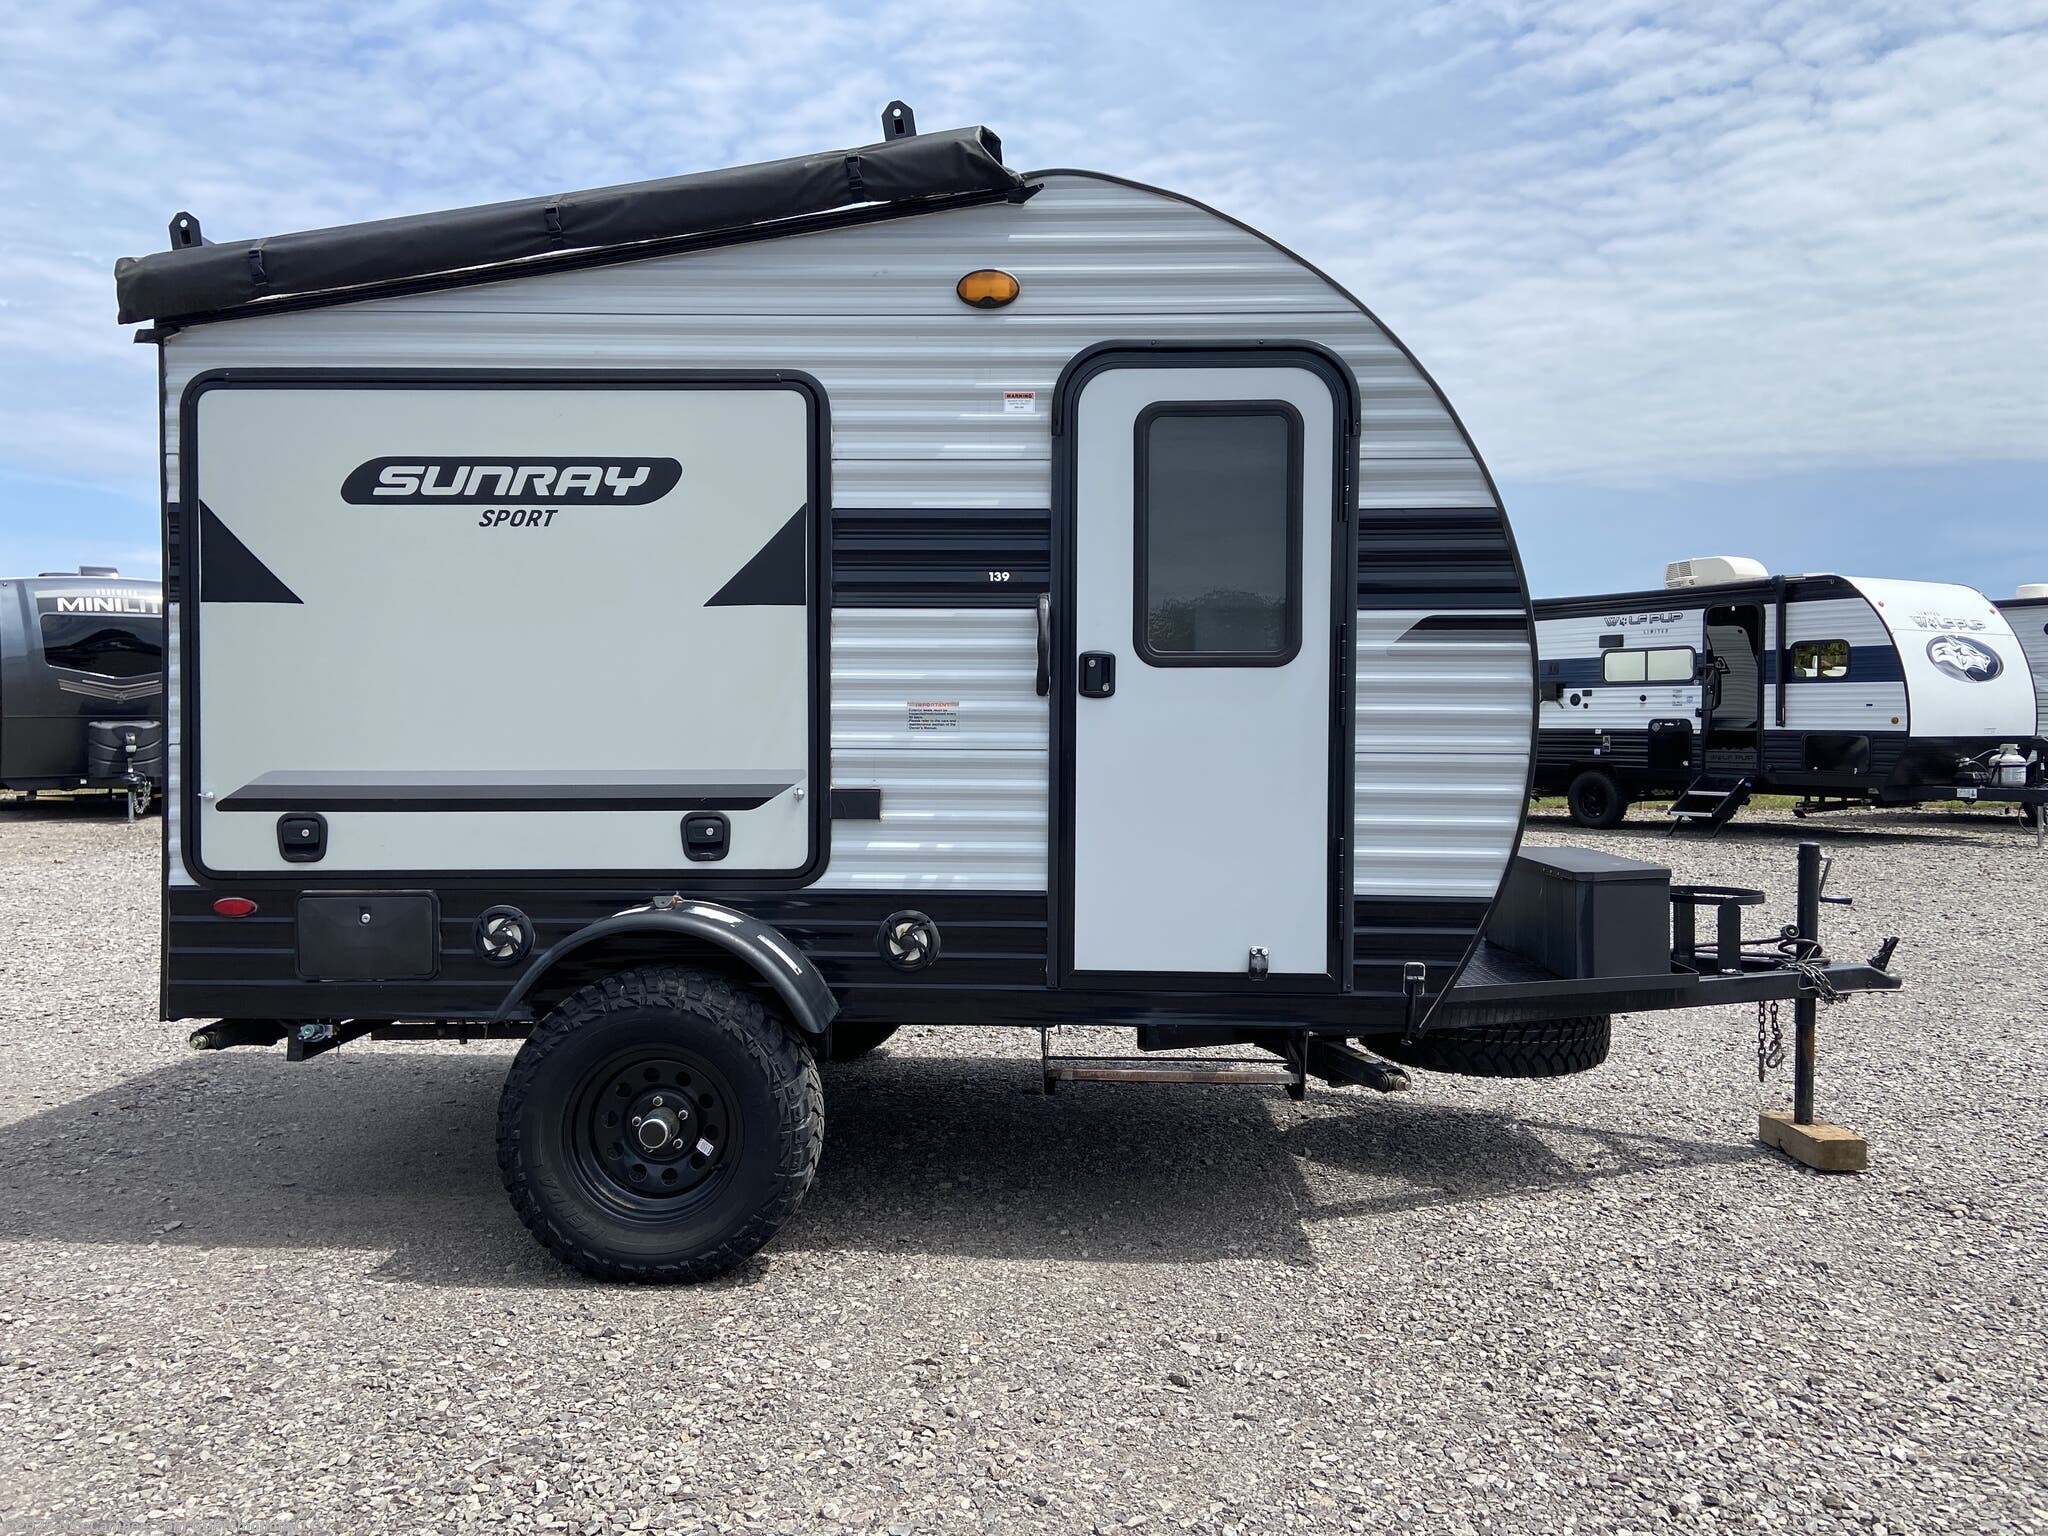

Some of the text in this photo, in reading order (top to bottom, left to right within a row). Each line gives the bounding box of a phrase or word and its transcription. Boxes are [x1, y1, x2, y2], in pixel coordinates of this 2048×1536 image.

[372, 465, 651, 497] SUNRAY
[478, 509, 559, 528] SPORT
[988, 571, 1010, 582] 139
